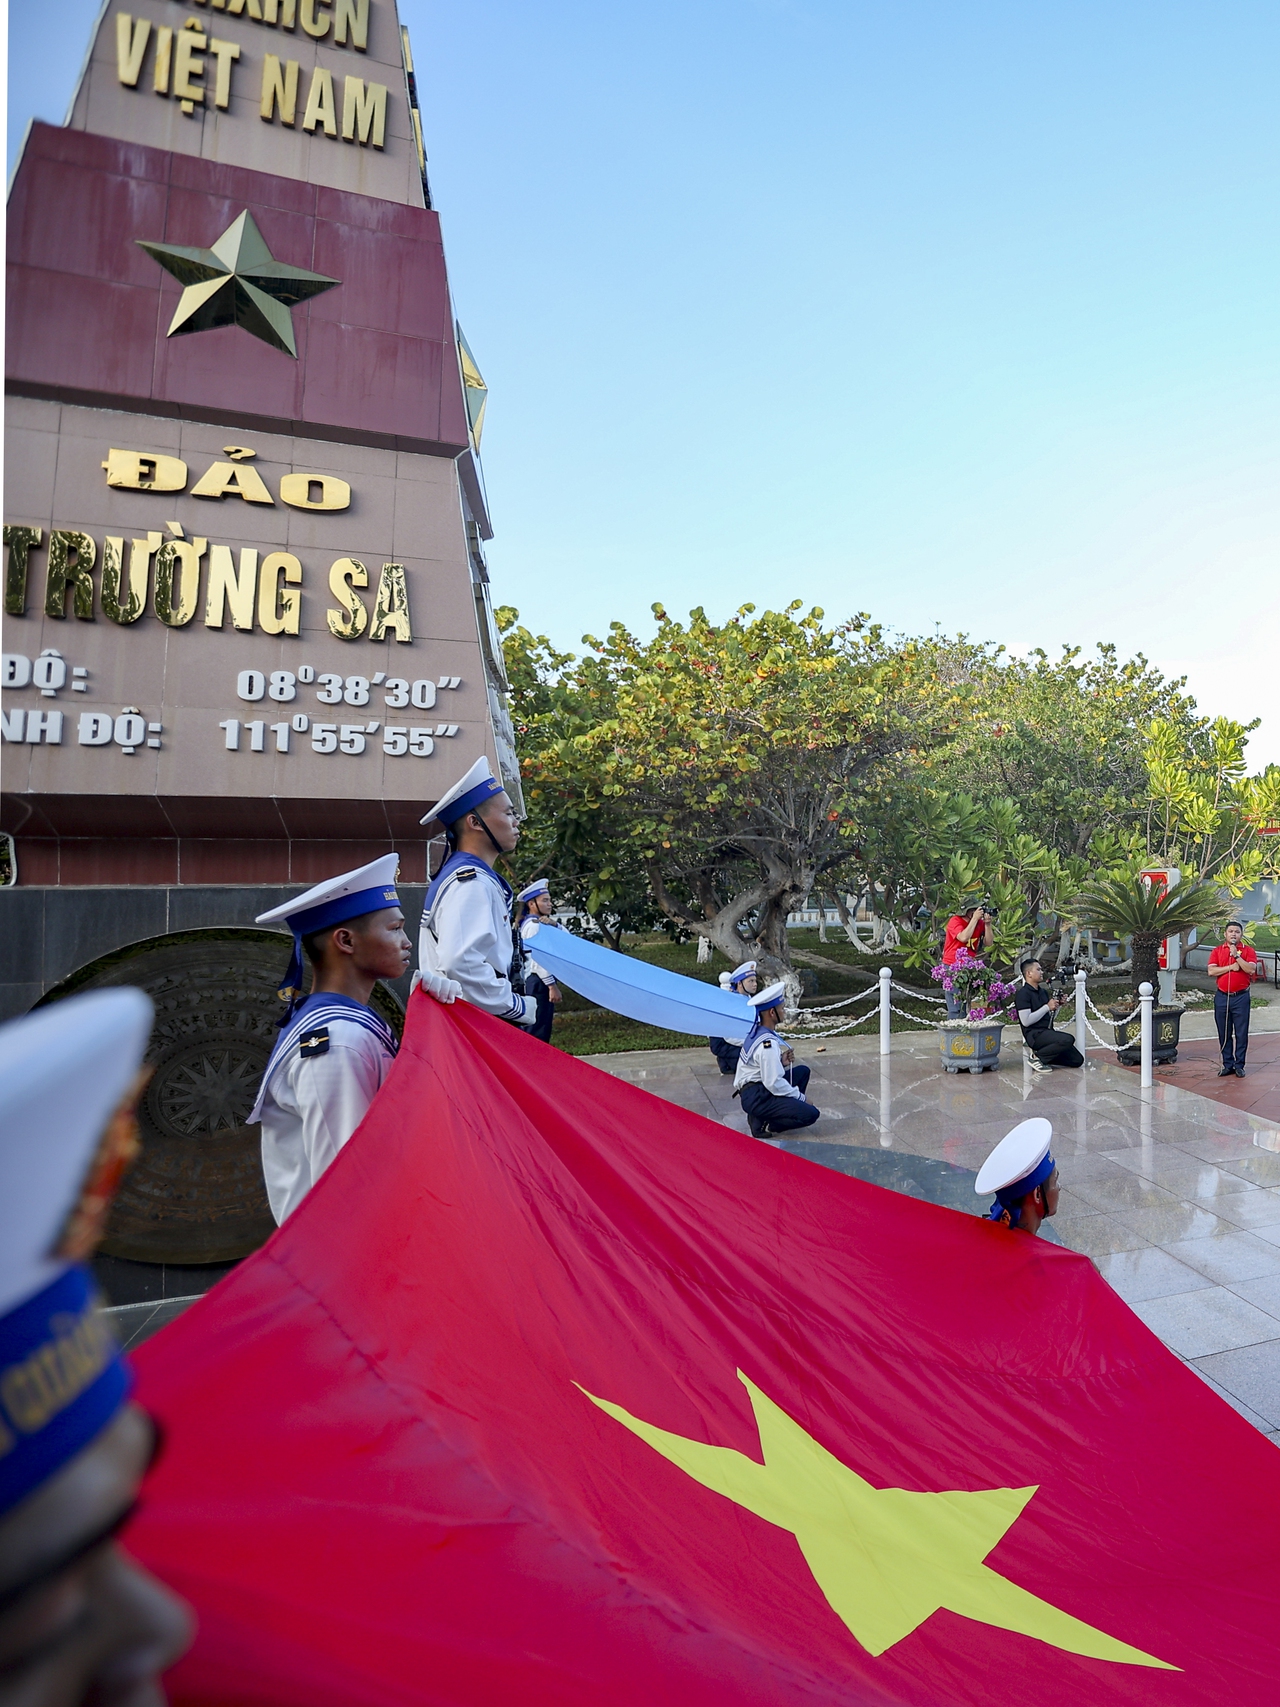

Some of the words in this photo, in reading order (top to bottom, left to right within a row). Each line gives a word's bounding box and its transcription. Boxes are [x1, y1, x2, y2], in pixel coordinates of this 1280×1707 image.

[117, 12, 241, 115] VIỆT
[260, 53, 387, 150] NAM
[101, 445, 352, 512] ĐẢO
[3, 521, 303, 636] TRƯỜNG
[327, 557, 413, 643] SA
[77, 706, 163, 756] ĐỘ:
